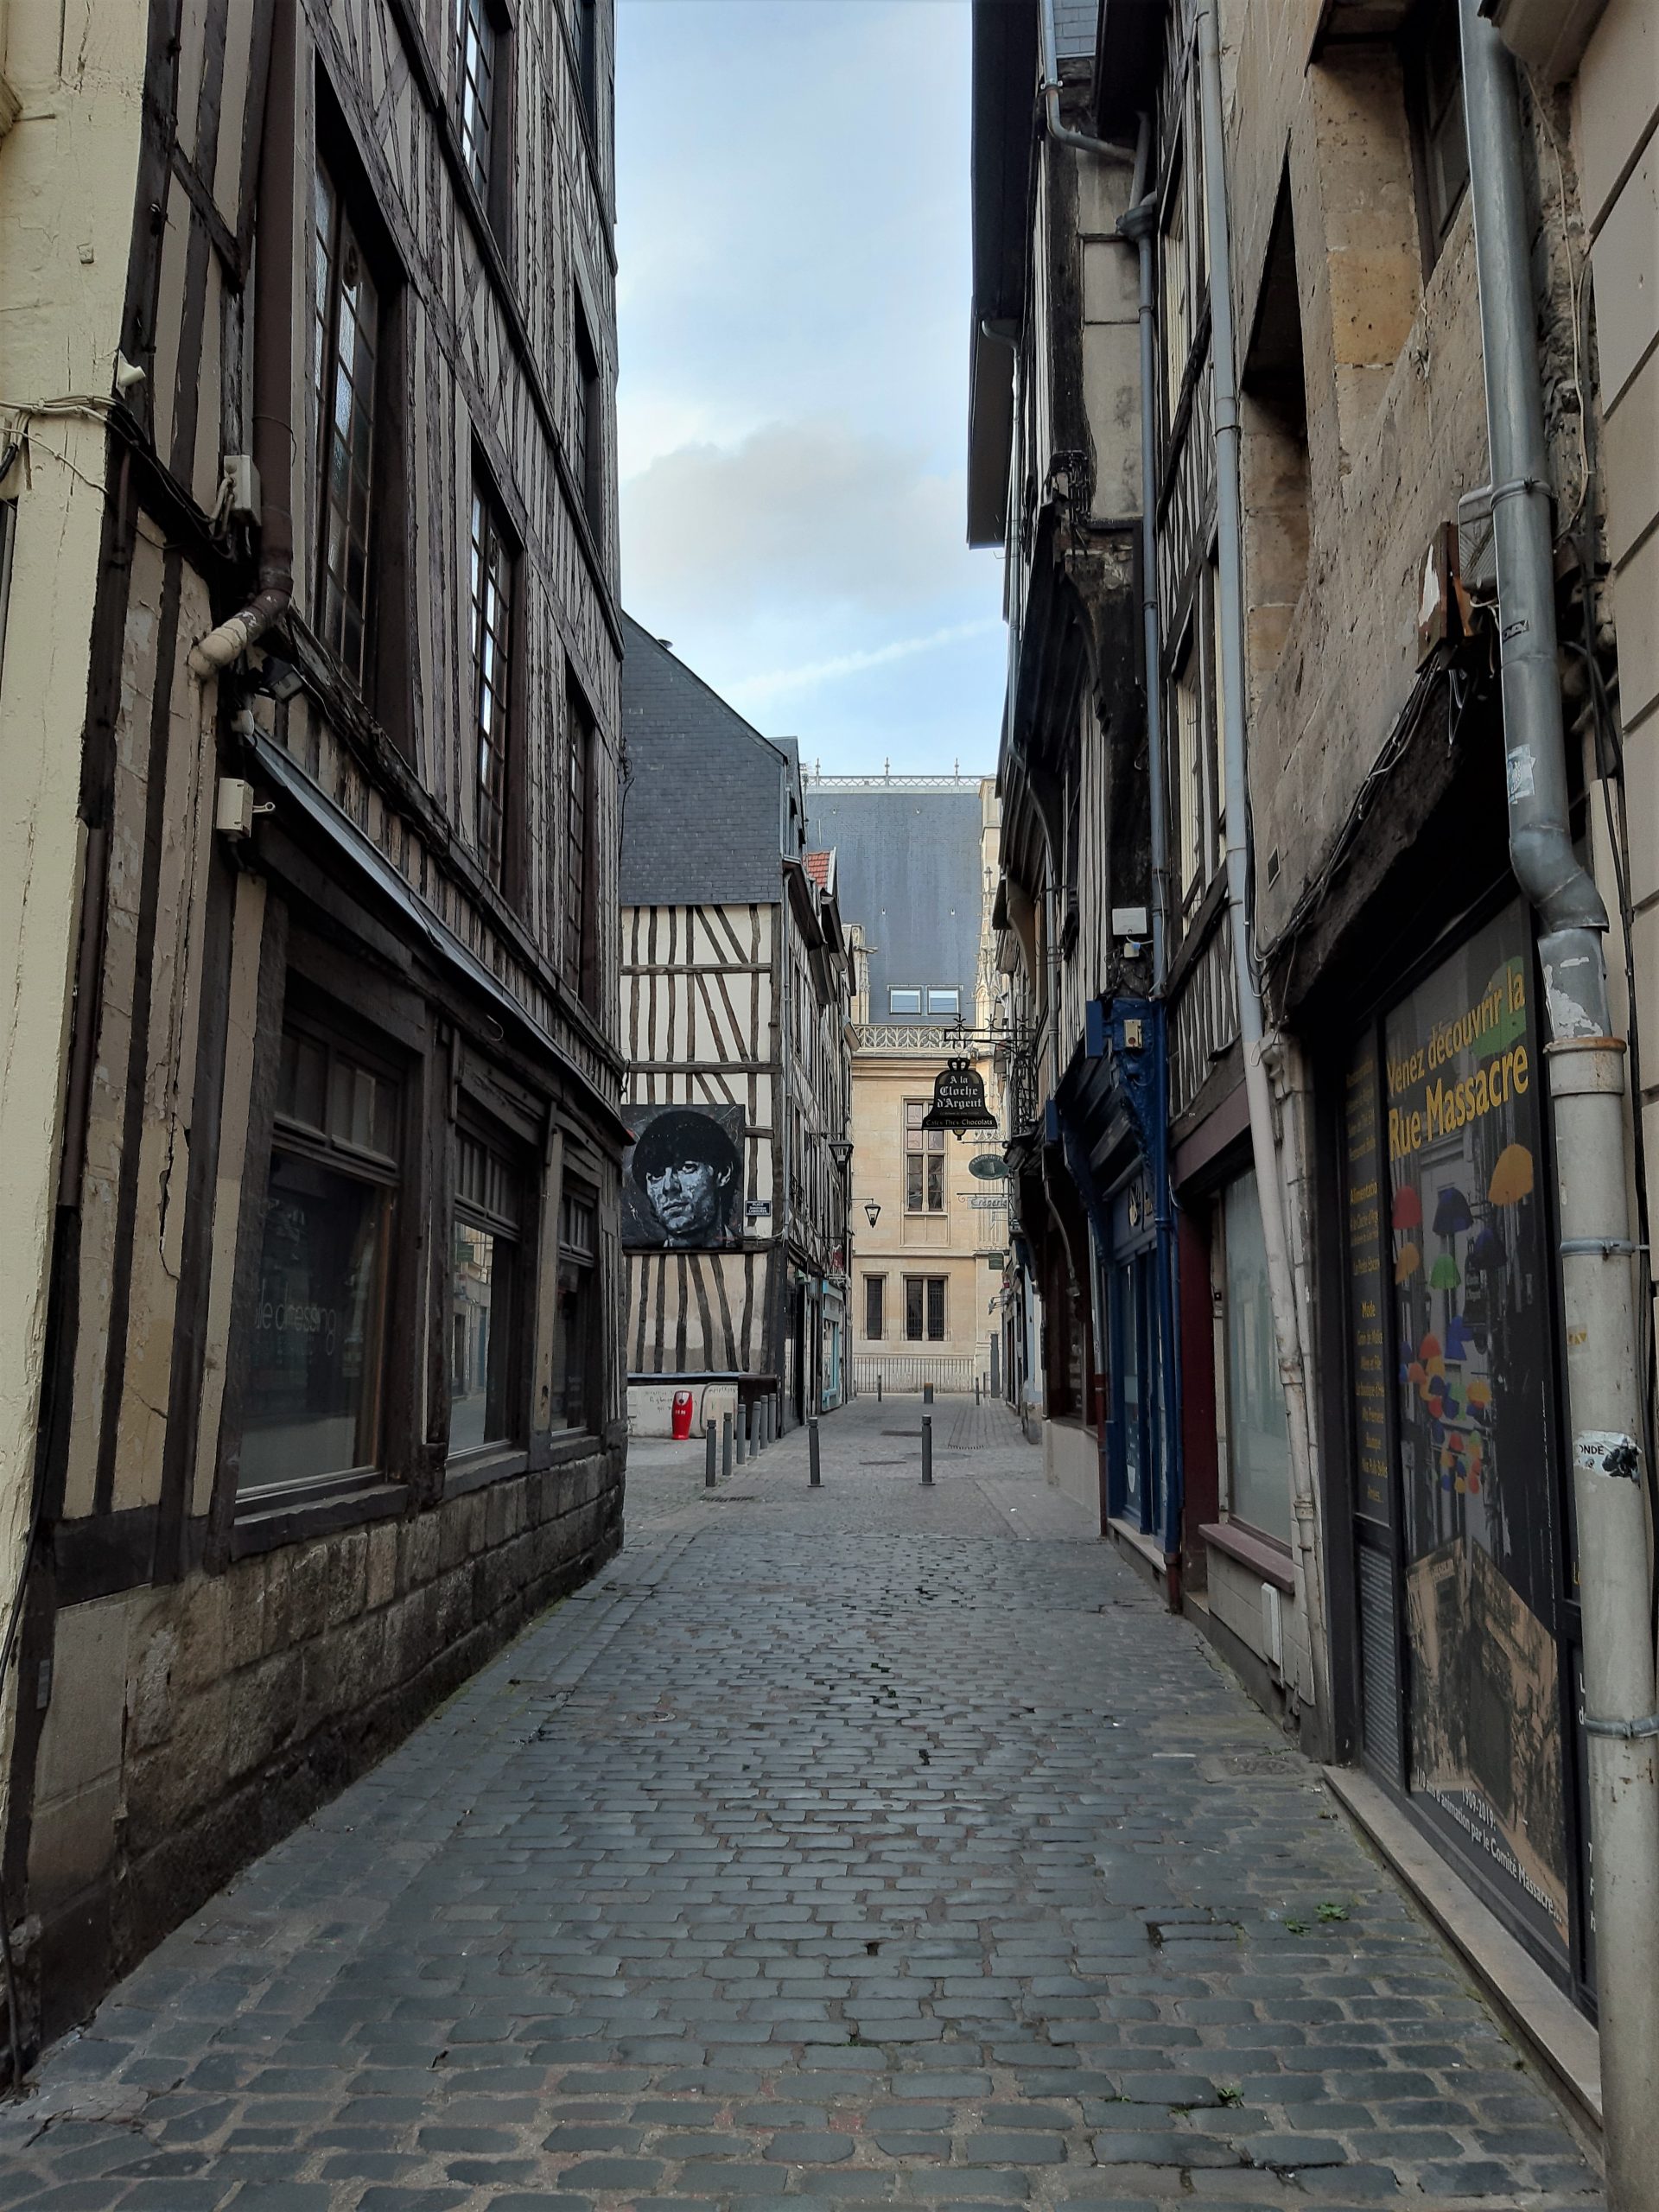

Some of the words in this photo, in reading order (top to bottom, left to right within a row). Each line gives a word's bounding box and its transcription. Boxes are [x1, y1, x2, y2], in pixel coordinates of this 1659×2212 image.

[1386, 1048, 1425, 1097] Venez
[1427, 981, 1503, 1071] découvrir
[1507, 966, 1525, 1014] la
[937, 1098, 982, 1109] d'Argent
[939, 1086, 978, 1097] Cloche
[950, 1075, 957, 1084] A
[1389, 1107, 1421, 1161] Rue
[1426, 1045, 1529, 1142] Massacre
[1416, 1766, 1426, 1789] 110
[1471, 1822, 1483, 1843] par
[1483, 1829, 1490, 1852] le
[1491, 1837, 1517, 1878] Comité
